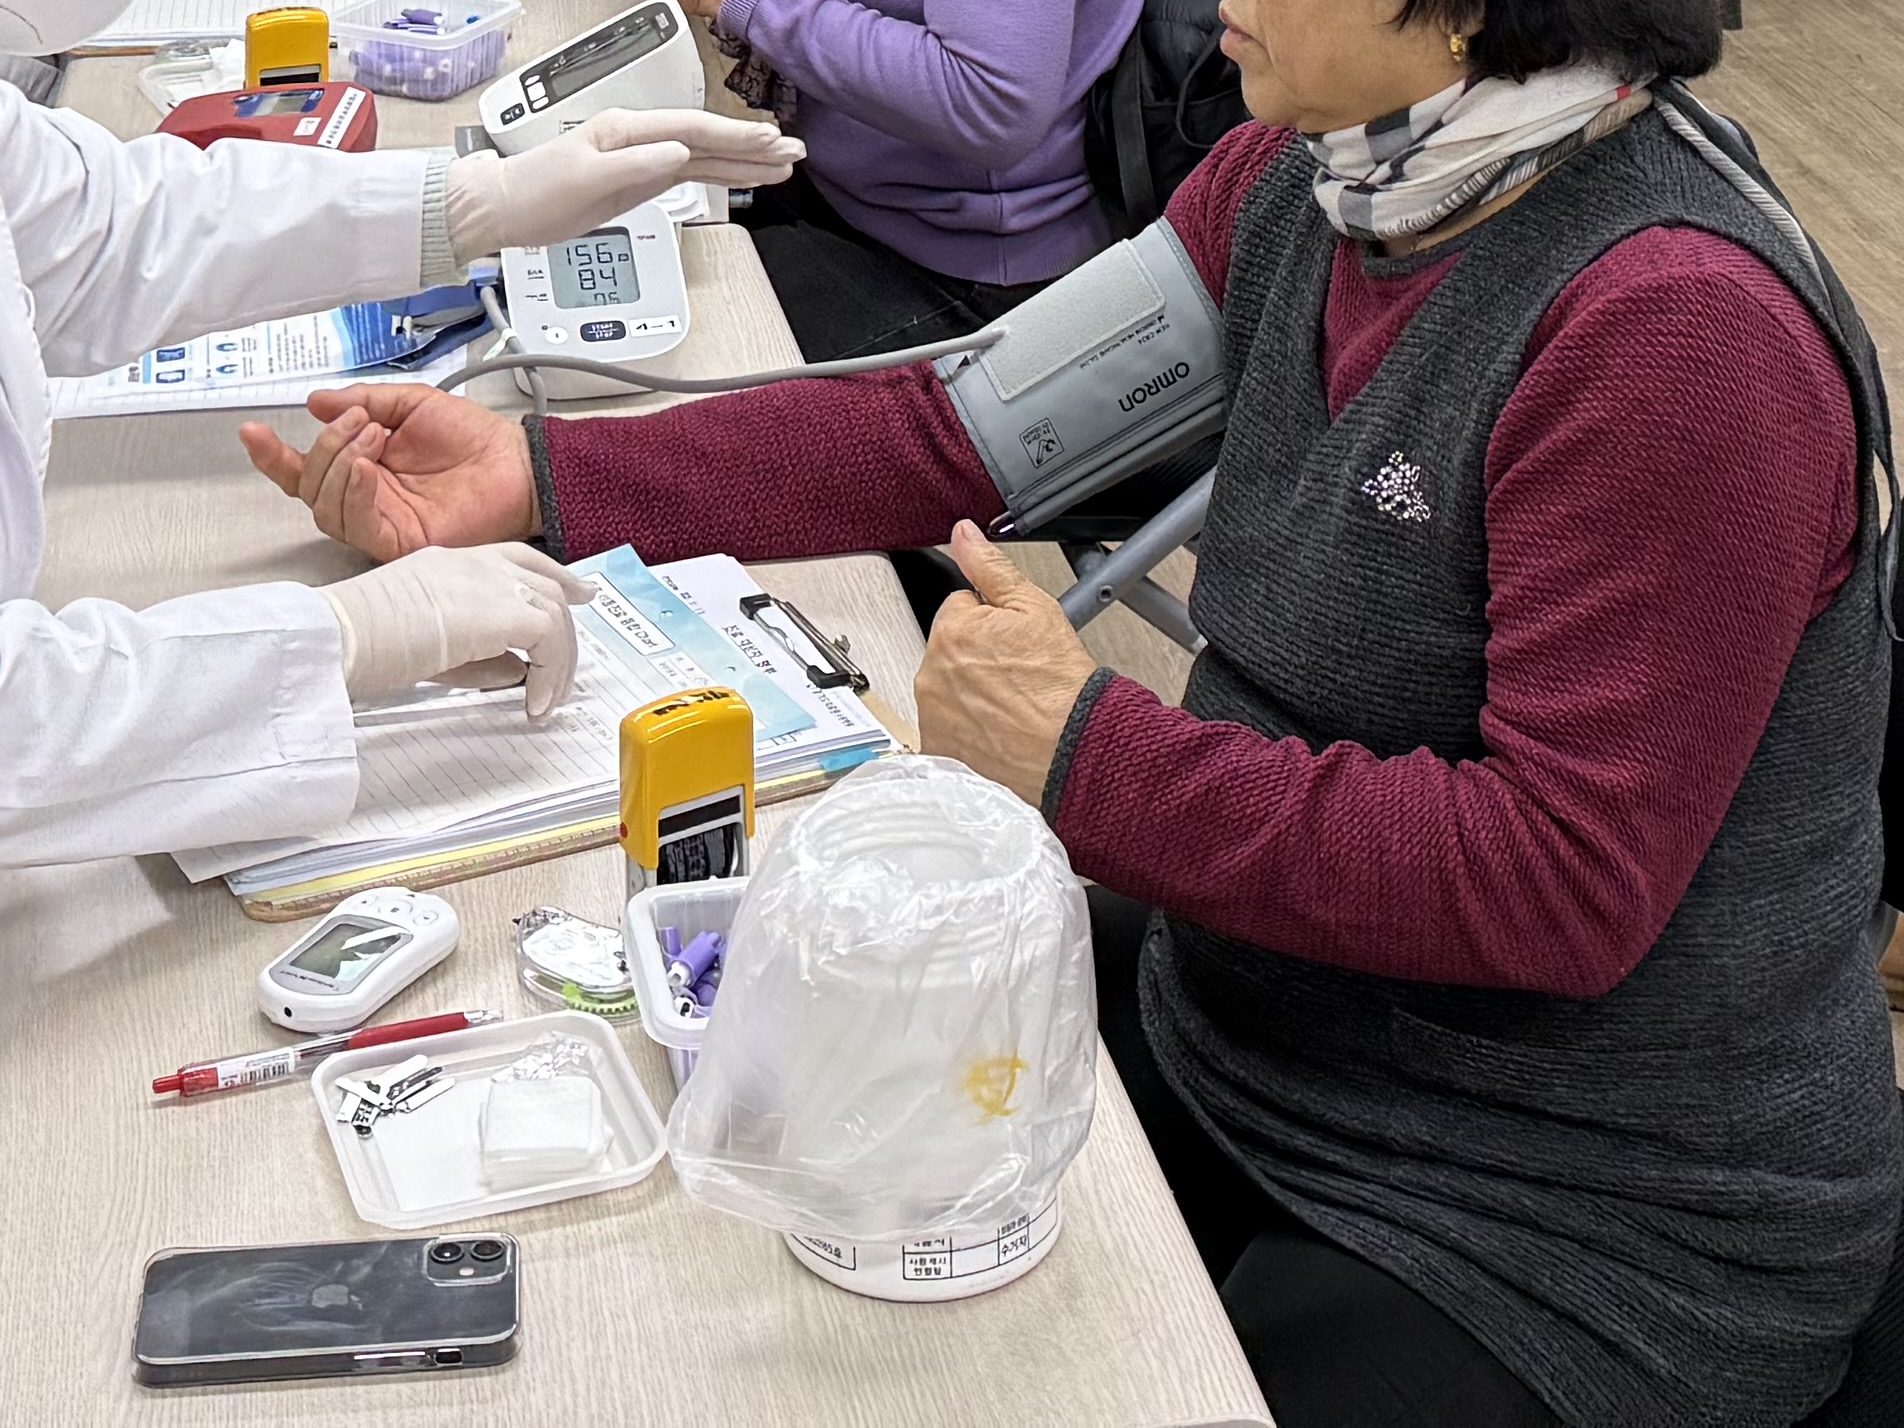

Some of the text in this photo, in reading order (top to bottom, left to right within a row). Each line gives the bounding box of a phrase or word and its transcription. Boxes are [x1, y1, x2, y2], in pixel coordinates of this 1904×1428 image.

[566, 242, 614, 266] 156
[578, 266, 618, 291] 84
[1117, 361, 1190, 412] OMRON
